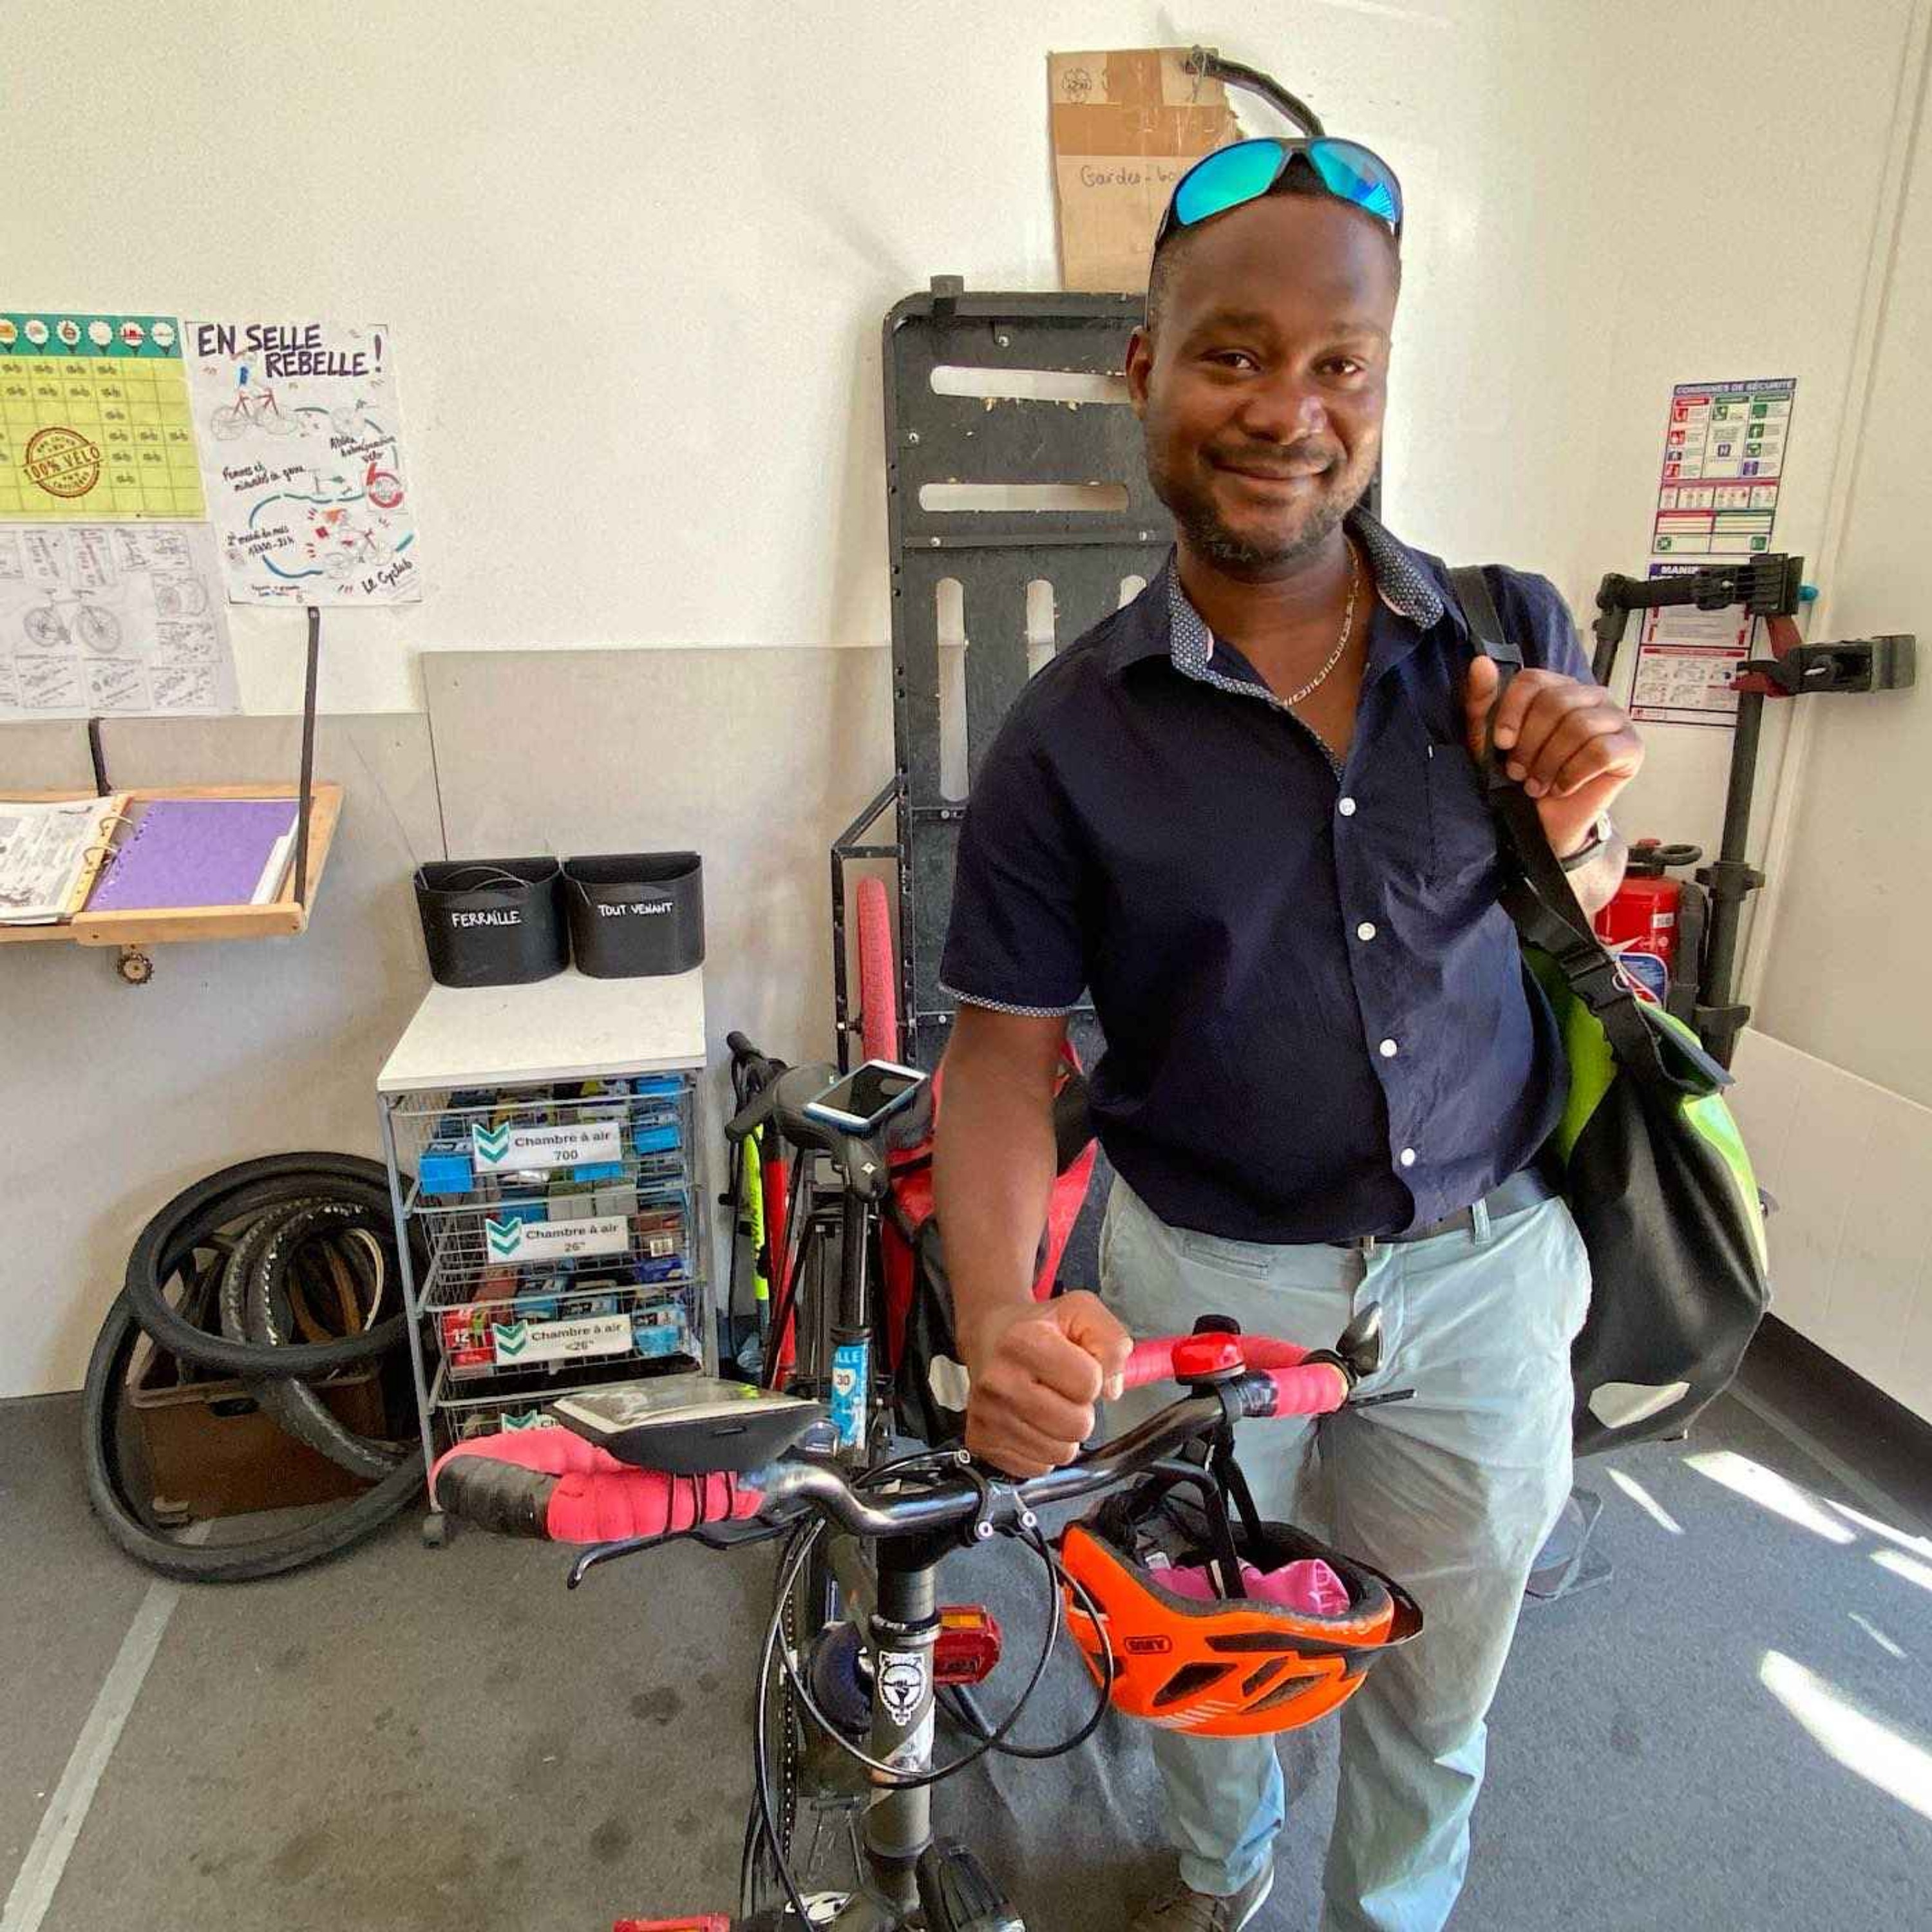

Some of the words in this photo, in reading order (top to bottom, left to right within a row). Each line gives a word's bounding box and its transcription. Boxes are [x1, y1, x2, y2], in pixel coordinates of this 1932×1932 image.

[198, 324, 236, 357] EN
[245, 324, 322, 352] SELLE
[597, 904, 626, 917] TOUT
[630, 902, 674, 914] VENANT
[451, 910, 522, 928] FERRAILLE
[515, 1134, 578, 1147] Chambre
[582, 1133, 591, 1142] à
[593, 1131, 611, 1142] air
[553, 1150, 578, 1160] 700
[526, 1226, 586, 1239] Chambre
[590, 1224, 598, 1234] à
[600, 1224, 619, 1234] air
[531, 1325, 591, 1342] Chambre
[594, 1324, 601, 1334] à
[605, 1323, 622, 1334] air
[837, 1374, 850, 1385] 30
